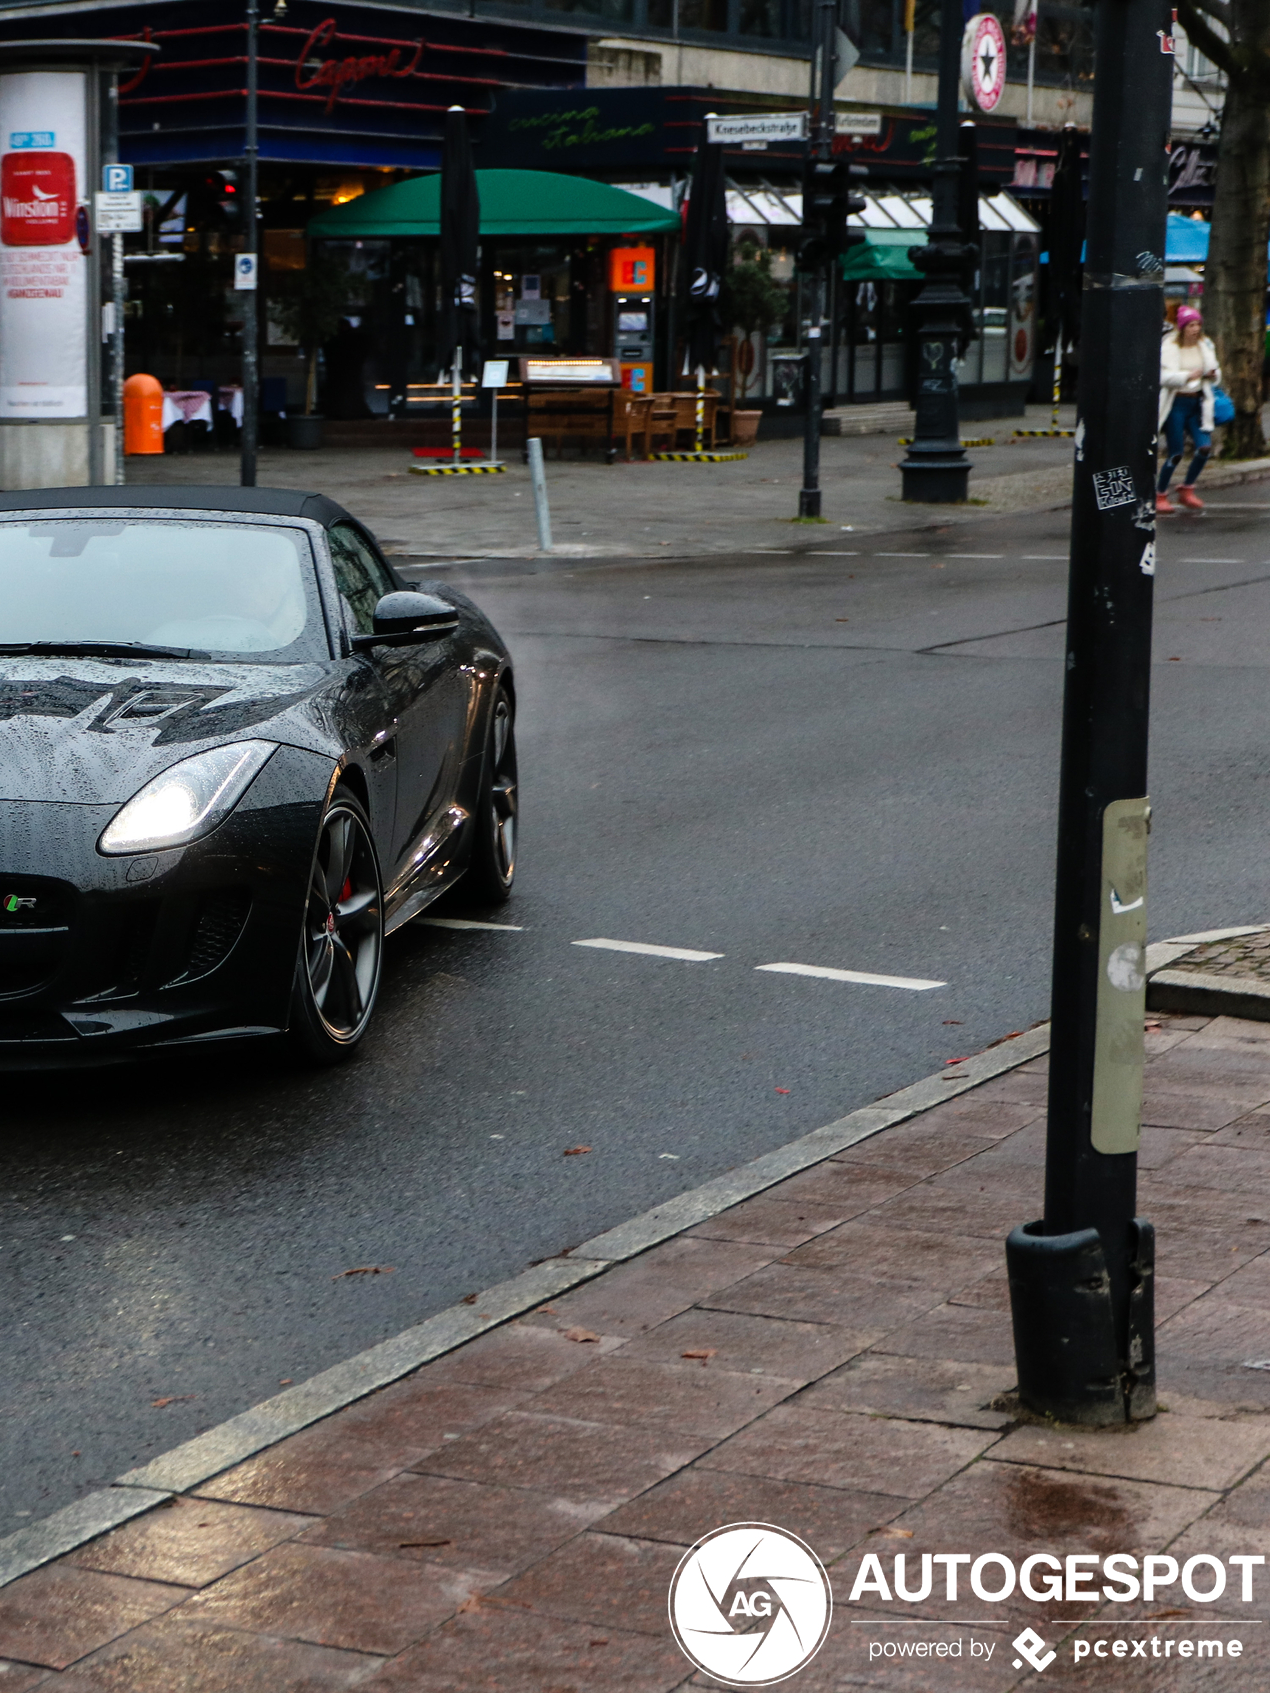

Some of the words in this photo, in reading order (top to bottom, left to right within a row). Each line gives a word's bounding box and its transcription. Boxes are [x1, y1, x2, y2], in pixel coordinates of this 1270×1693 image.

[715, 123, 797, 136] Knesebeckstraße
[110, 168, 127, 191] P
[2, 196, 59, 218] Winston
